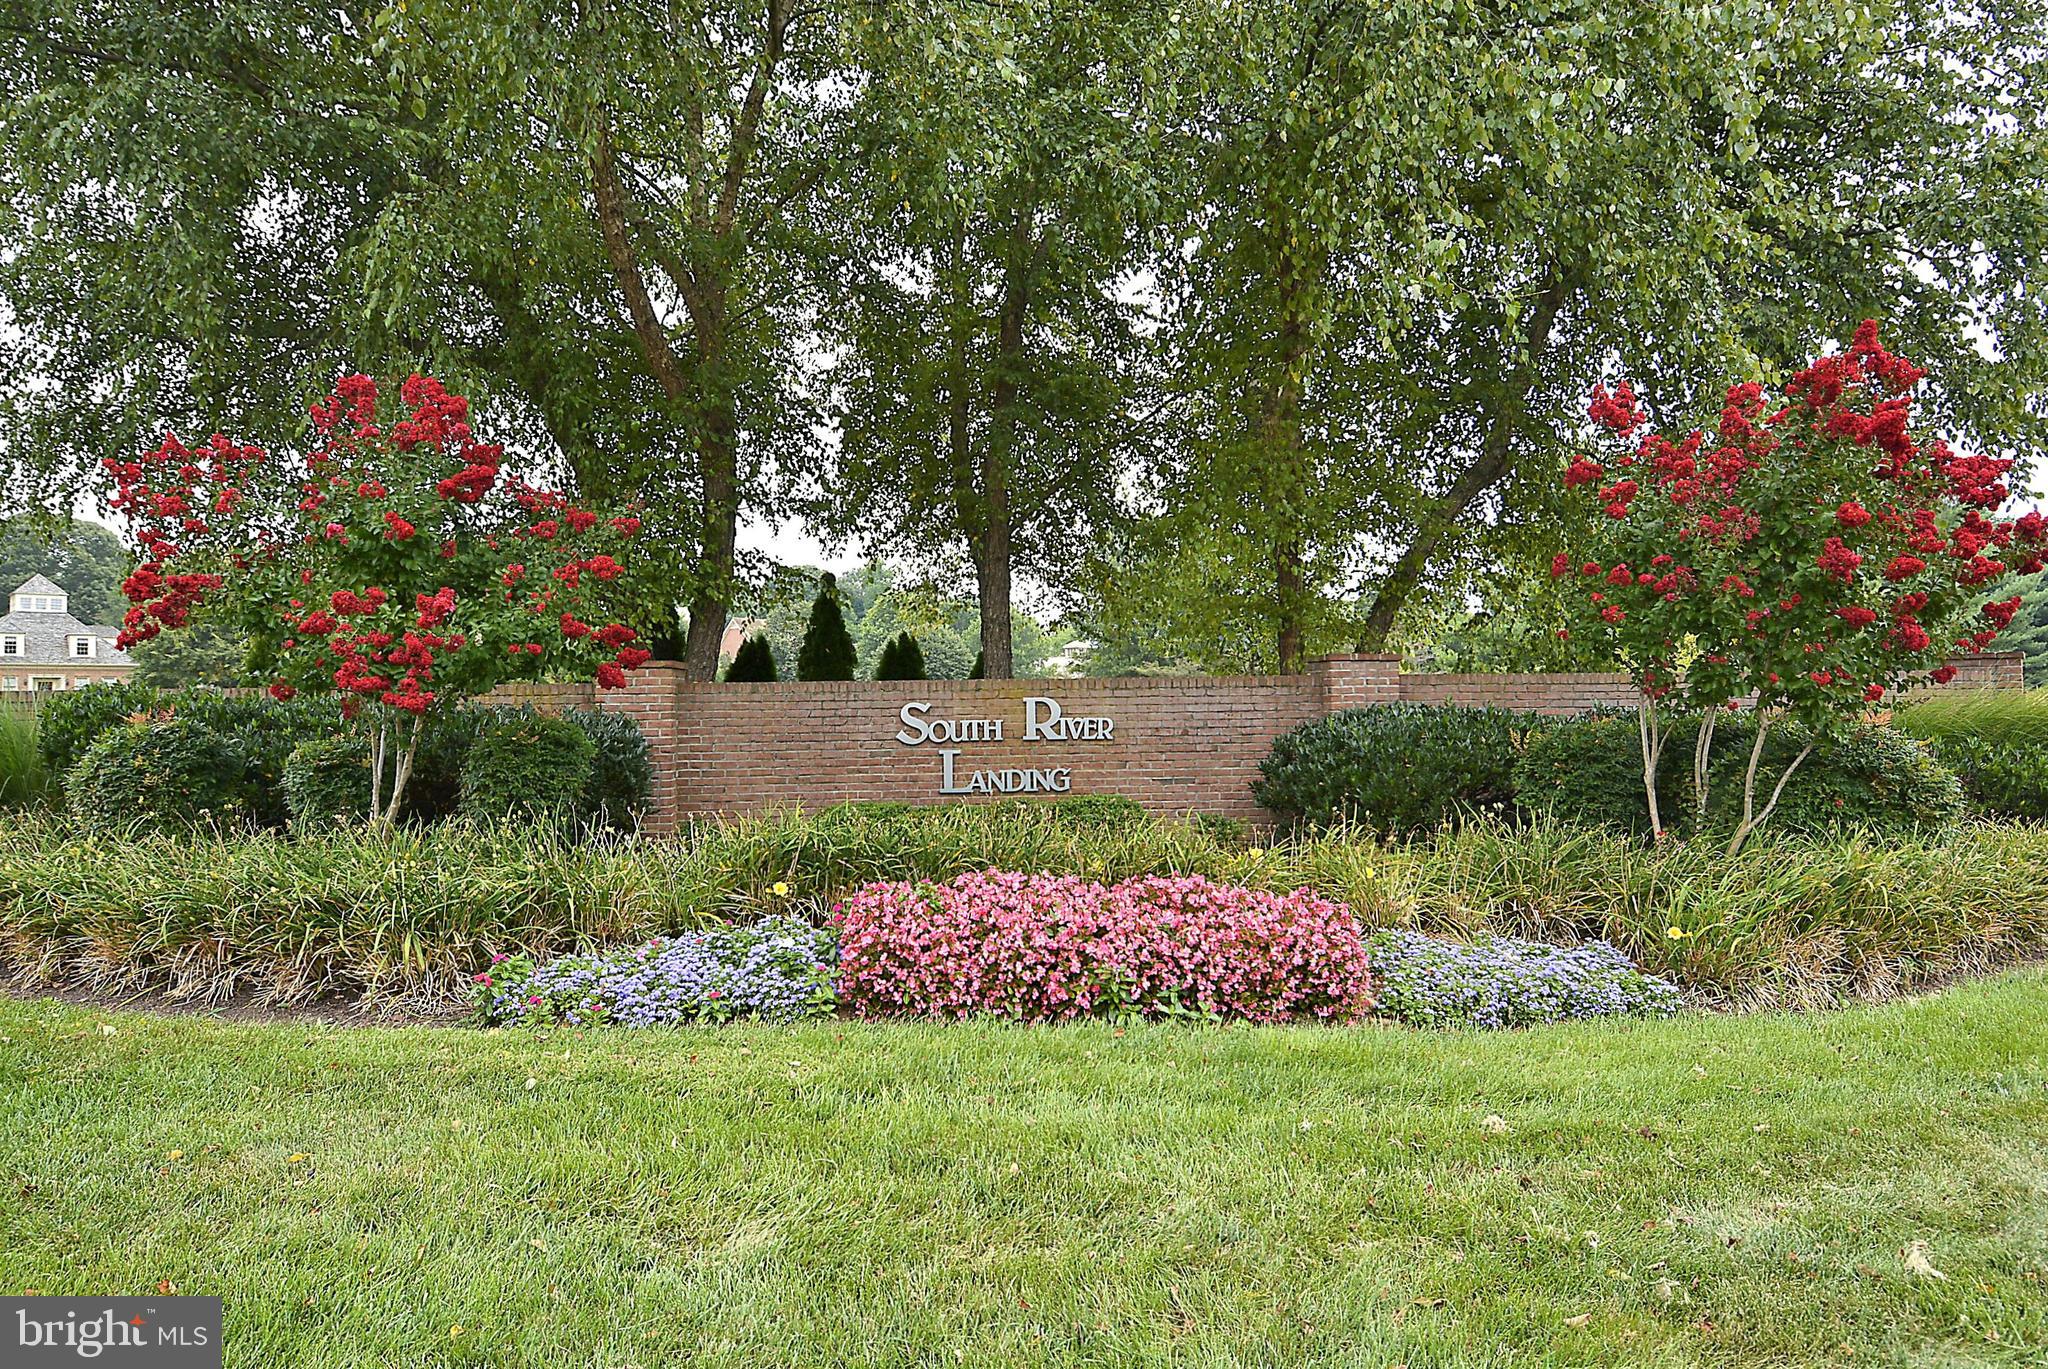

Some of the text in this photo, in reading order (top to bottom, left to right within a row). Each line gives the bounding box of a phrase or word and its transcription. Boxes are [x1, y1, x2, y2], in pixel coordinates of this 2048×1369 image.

[896, 697, 1115, 746] SOUTH RIVER
[938, 749, 1072, 794] LANDING
